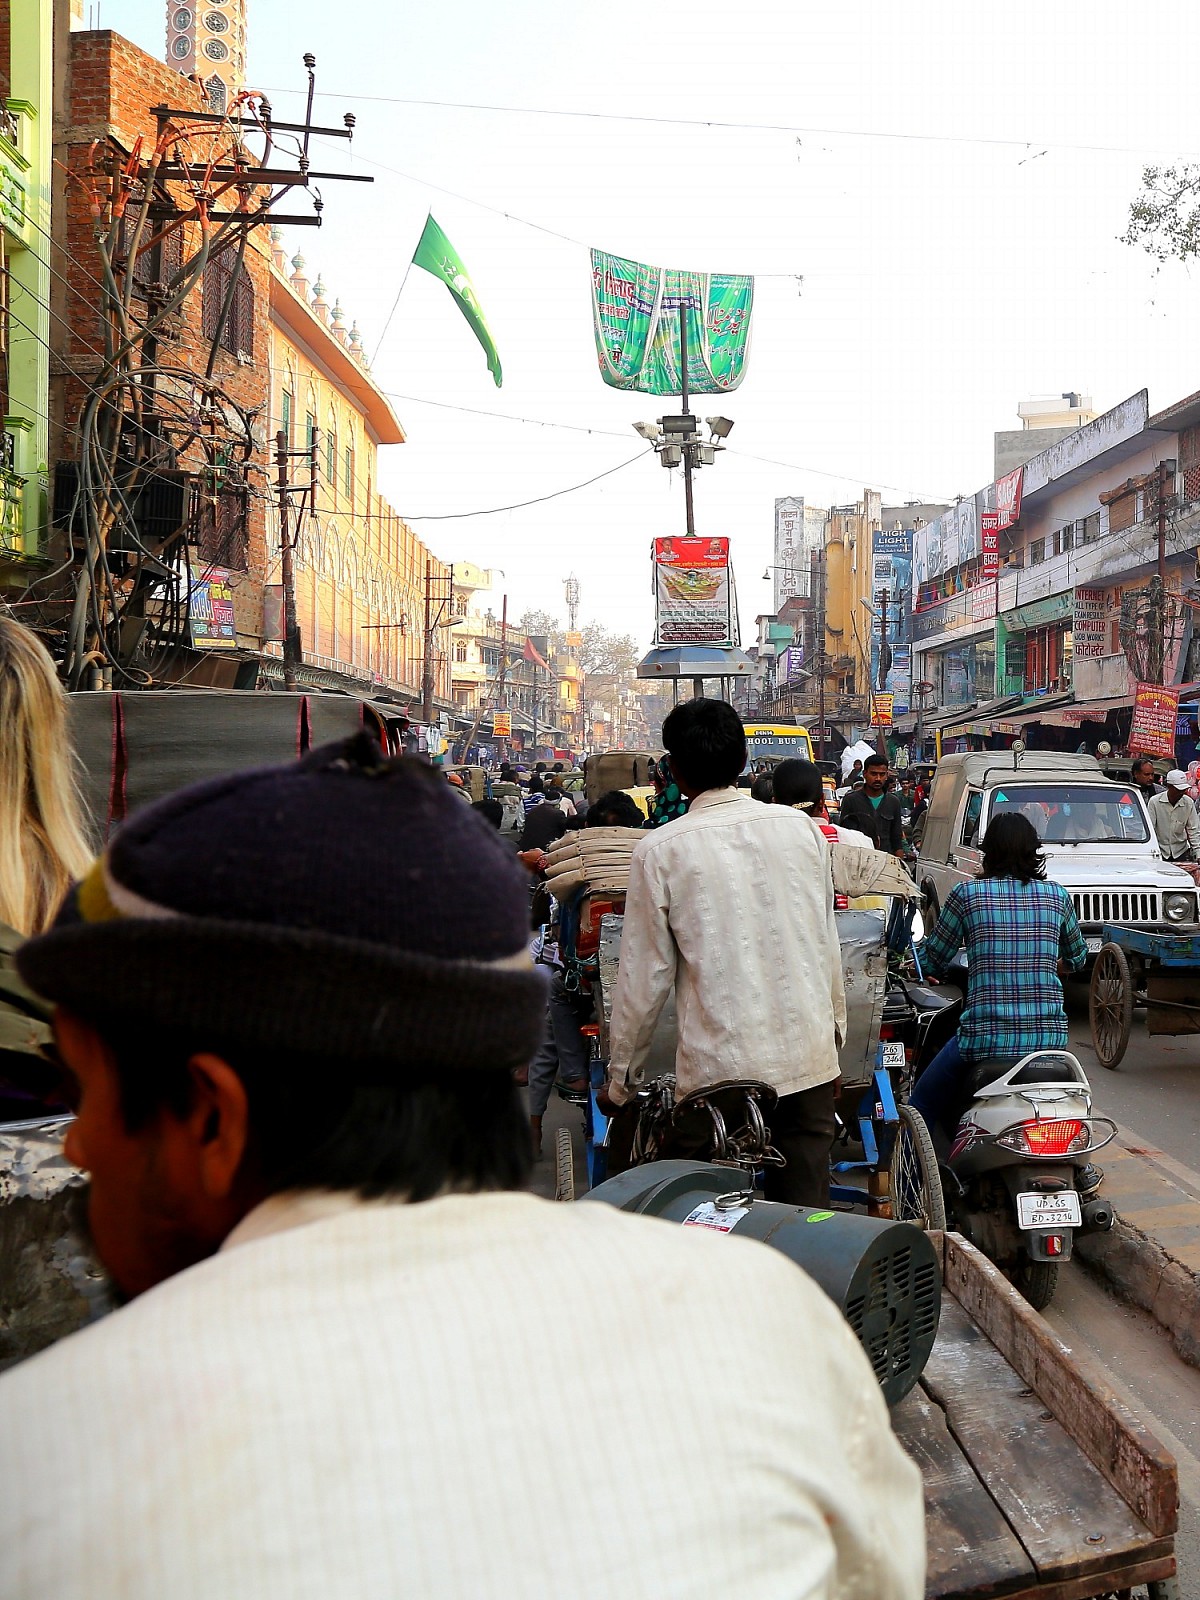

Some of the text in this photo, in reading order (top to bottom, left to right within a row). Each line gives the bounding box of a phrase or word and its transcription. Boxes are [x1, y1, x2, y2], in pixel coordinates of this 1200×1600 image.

[1075, 589, 1105, 602] INTERNET
[1074, 602, 1084, 610] ALL
[1085, 602, 1097, 610] TYPE
[1075, 611, 1087, 619] EXAM
[1075, 621, 1105, 633] COMPUTER
[1075, 633, 1105, 641] JOB WORKS
[778, 737, 797, 745] BUS
